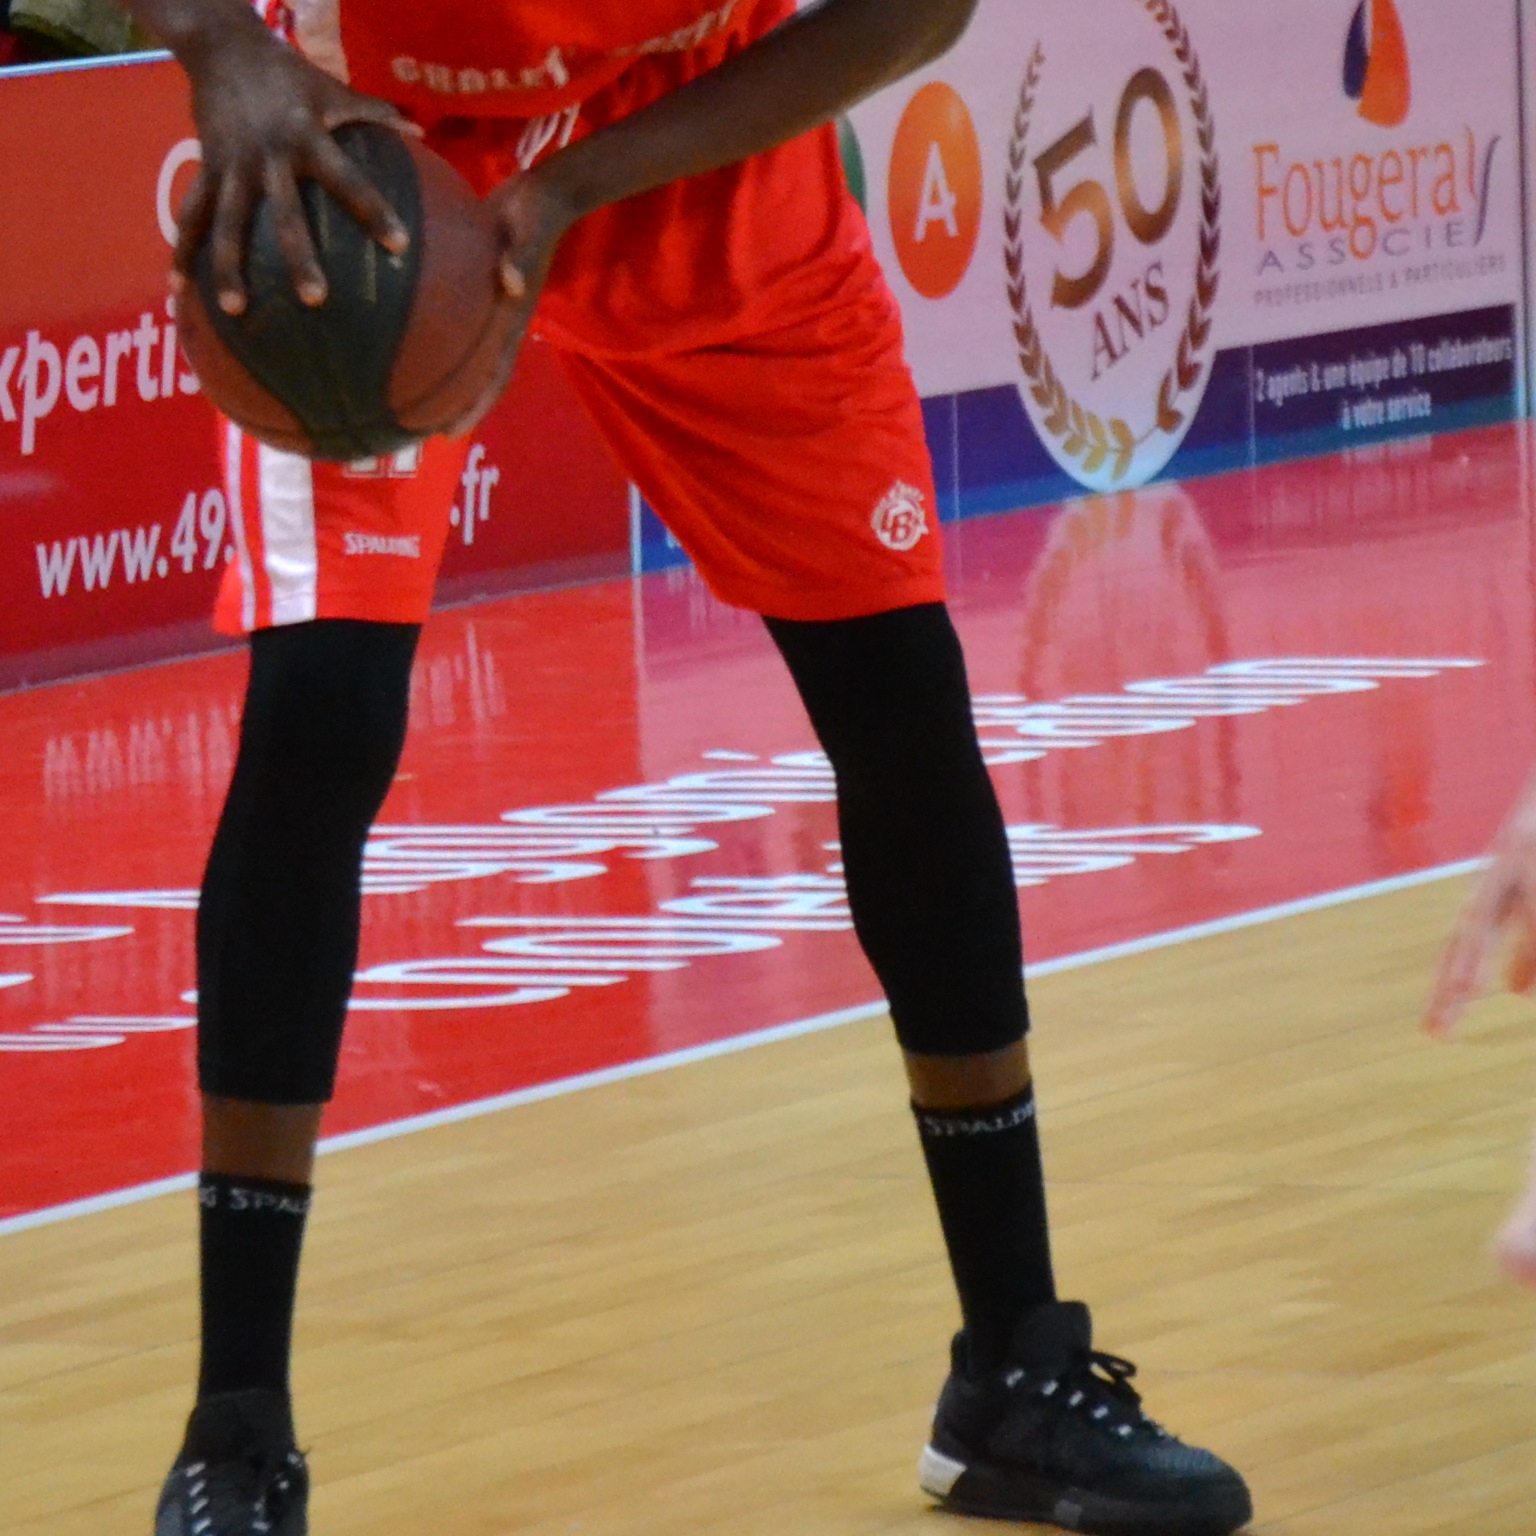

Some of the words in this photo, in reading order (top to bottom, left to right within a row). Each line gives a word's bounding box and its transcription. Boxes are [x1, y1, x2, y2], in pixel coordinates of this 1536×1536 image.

[1032, 66, 1184, 310] 50
[1090, 261, 1170, 382] ANS
[1267, 363, 1309, 407] agents
[1323, 364, 1348, 392] une
[1391, 346, 1407, 379] de
[1427, 335, 1513, 373] collaborateurs
[1352, 396, 1386, 428] votre
[1386, 386, 1432, 423] service
